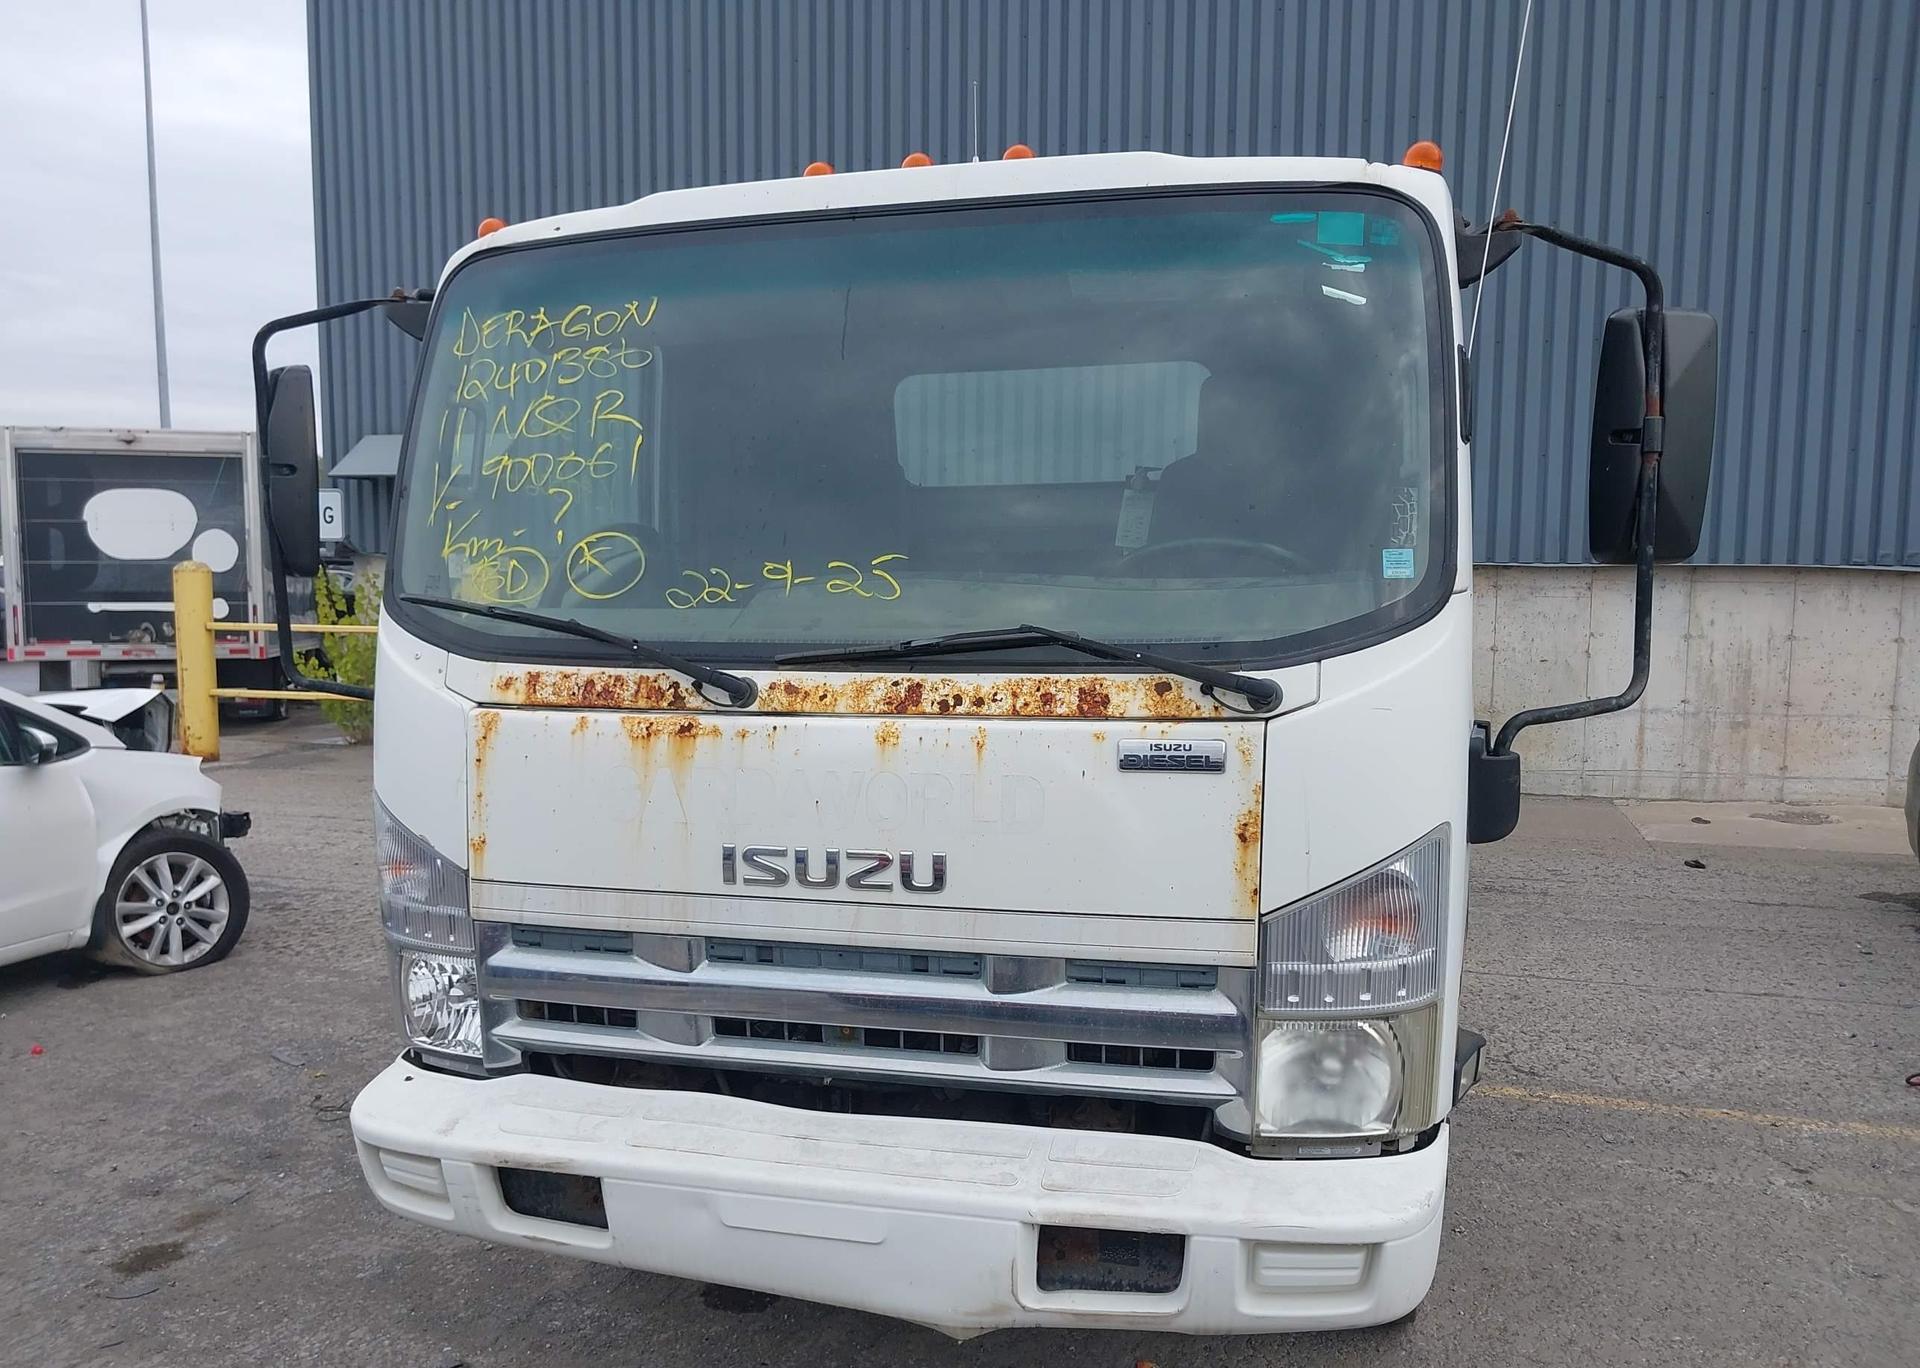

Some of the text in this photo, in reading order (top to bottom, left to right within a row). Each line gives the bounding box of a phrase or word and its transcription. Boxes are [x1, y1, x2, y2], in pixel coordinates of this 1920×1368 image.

[453, 296, 657, 360] DERAGON
[481, 434, 643, 500] 900061
[323, 506, 334, 524] G
[1120, 754, 1223, 769] DIESEL
[1149, 743, 1192, 752] ISUZU
[721, 842, 947, 893] ISUZU
